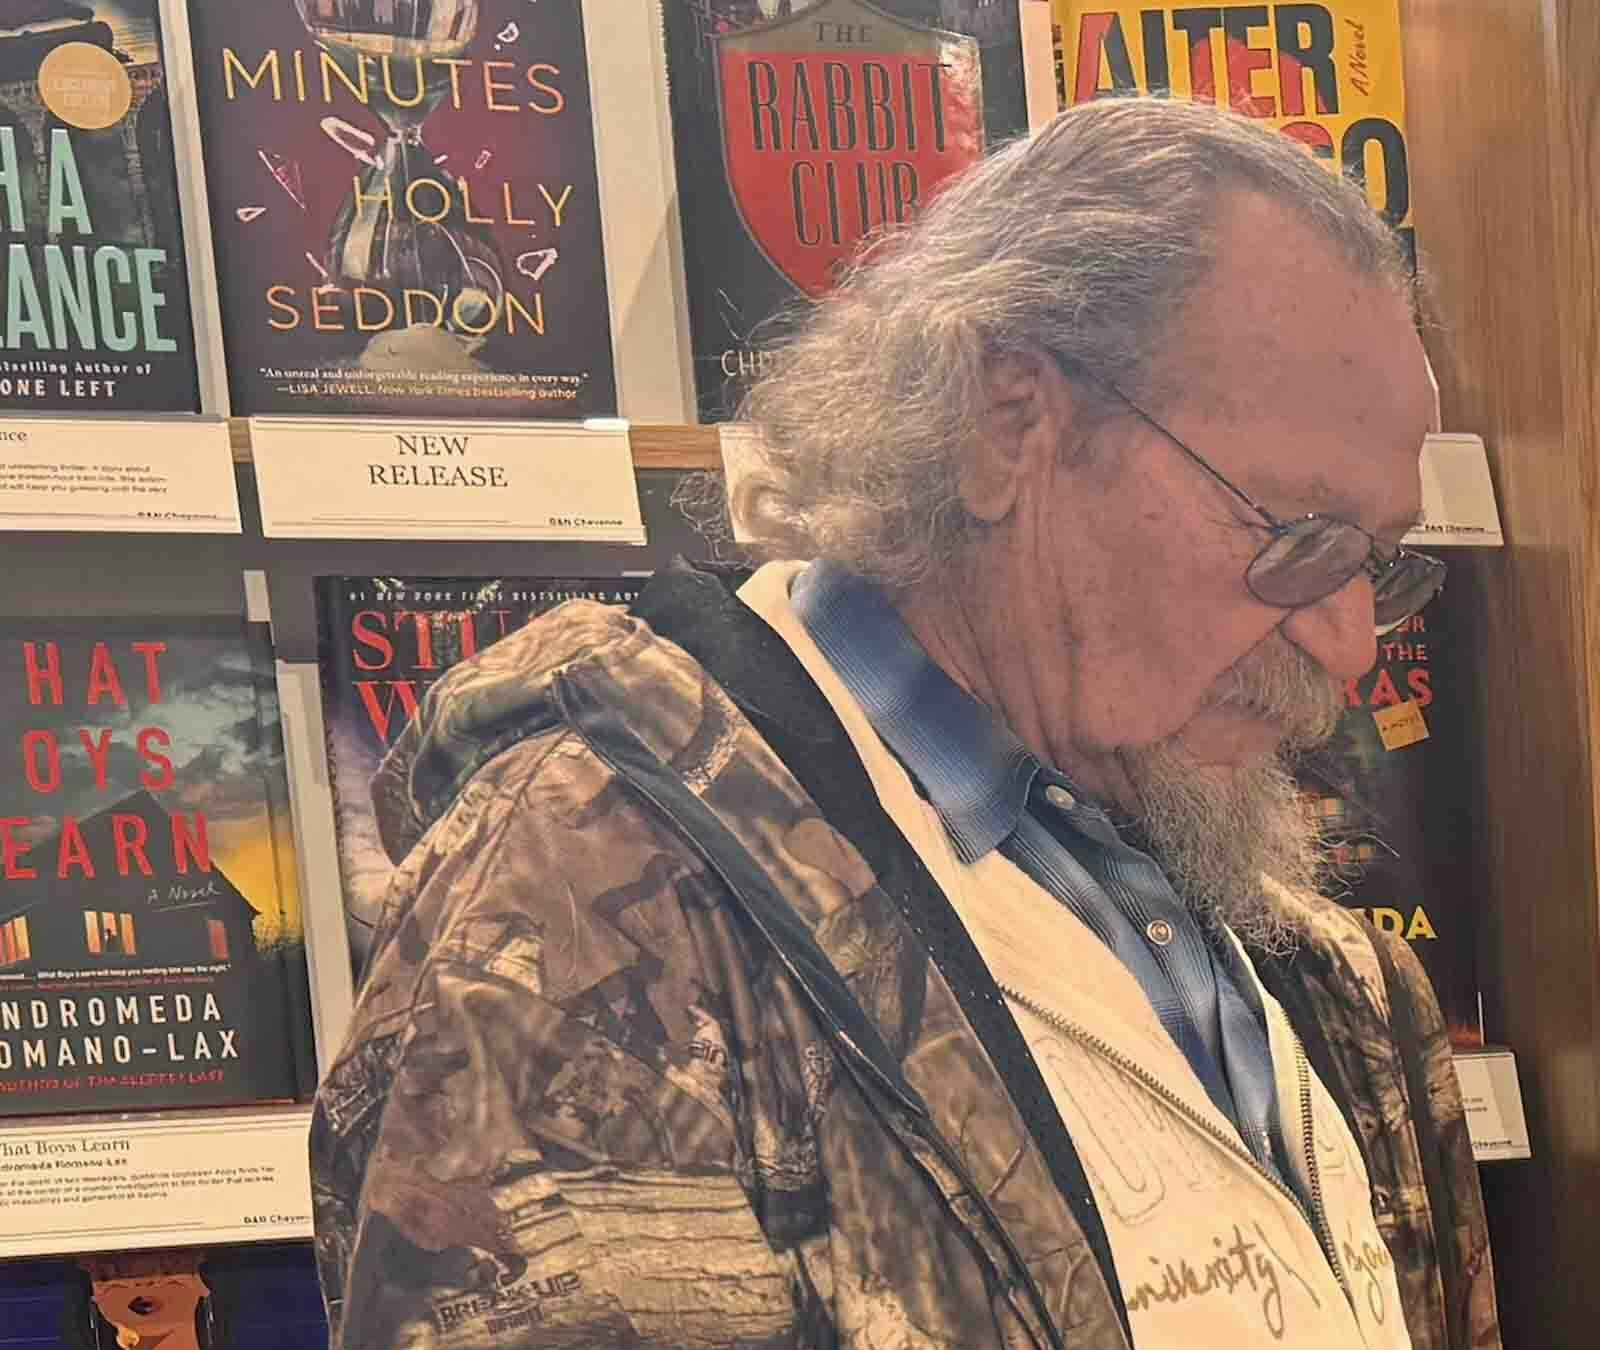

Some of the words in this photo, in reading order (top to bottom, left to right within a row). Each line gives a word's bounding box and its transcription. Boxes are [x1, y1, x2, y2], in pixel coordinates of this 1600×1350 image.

[815, 22, 872, 44] THE
[223, 46, 565, 115] MINUTES
[747, 61, 951, 153] RABBIT
[50, 128, 93, 235] A
[354, 175, 572, 228] HOLLY
[791, 160, 919, 248] CLUB
[267, 284, 545, 337] SEDDON
[75, 361, 129, 375] Author
[136, 361, 152, 375] of
[0, 380, 46, 398] ONE
[60, 380, 117, 398] LEFT
[396, 435, 469, 457] NEW
[369, 465, 509, 488] RELEASE
[1383, 643, 1429, 661] THE
[1, 810, 213, 881] EARN
[2, 993, 222, 1031] NDROMEDA
[81, 1138, 131, 1153] Learn
